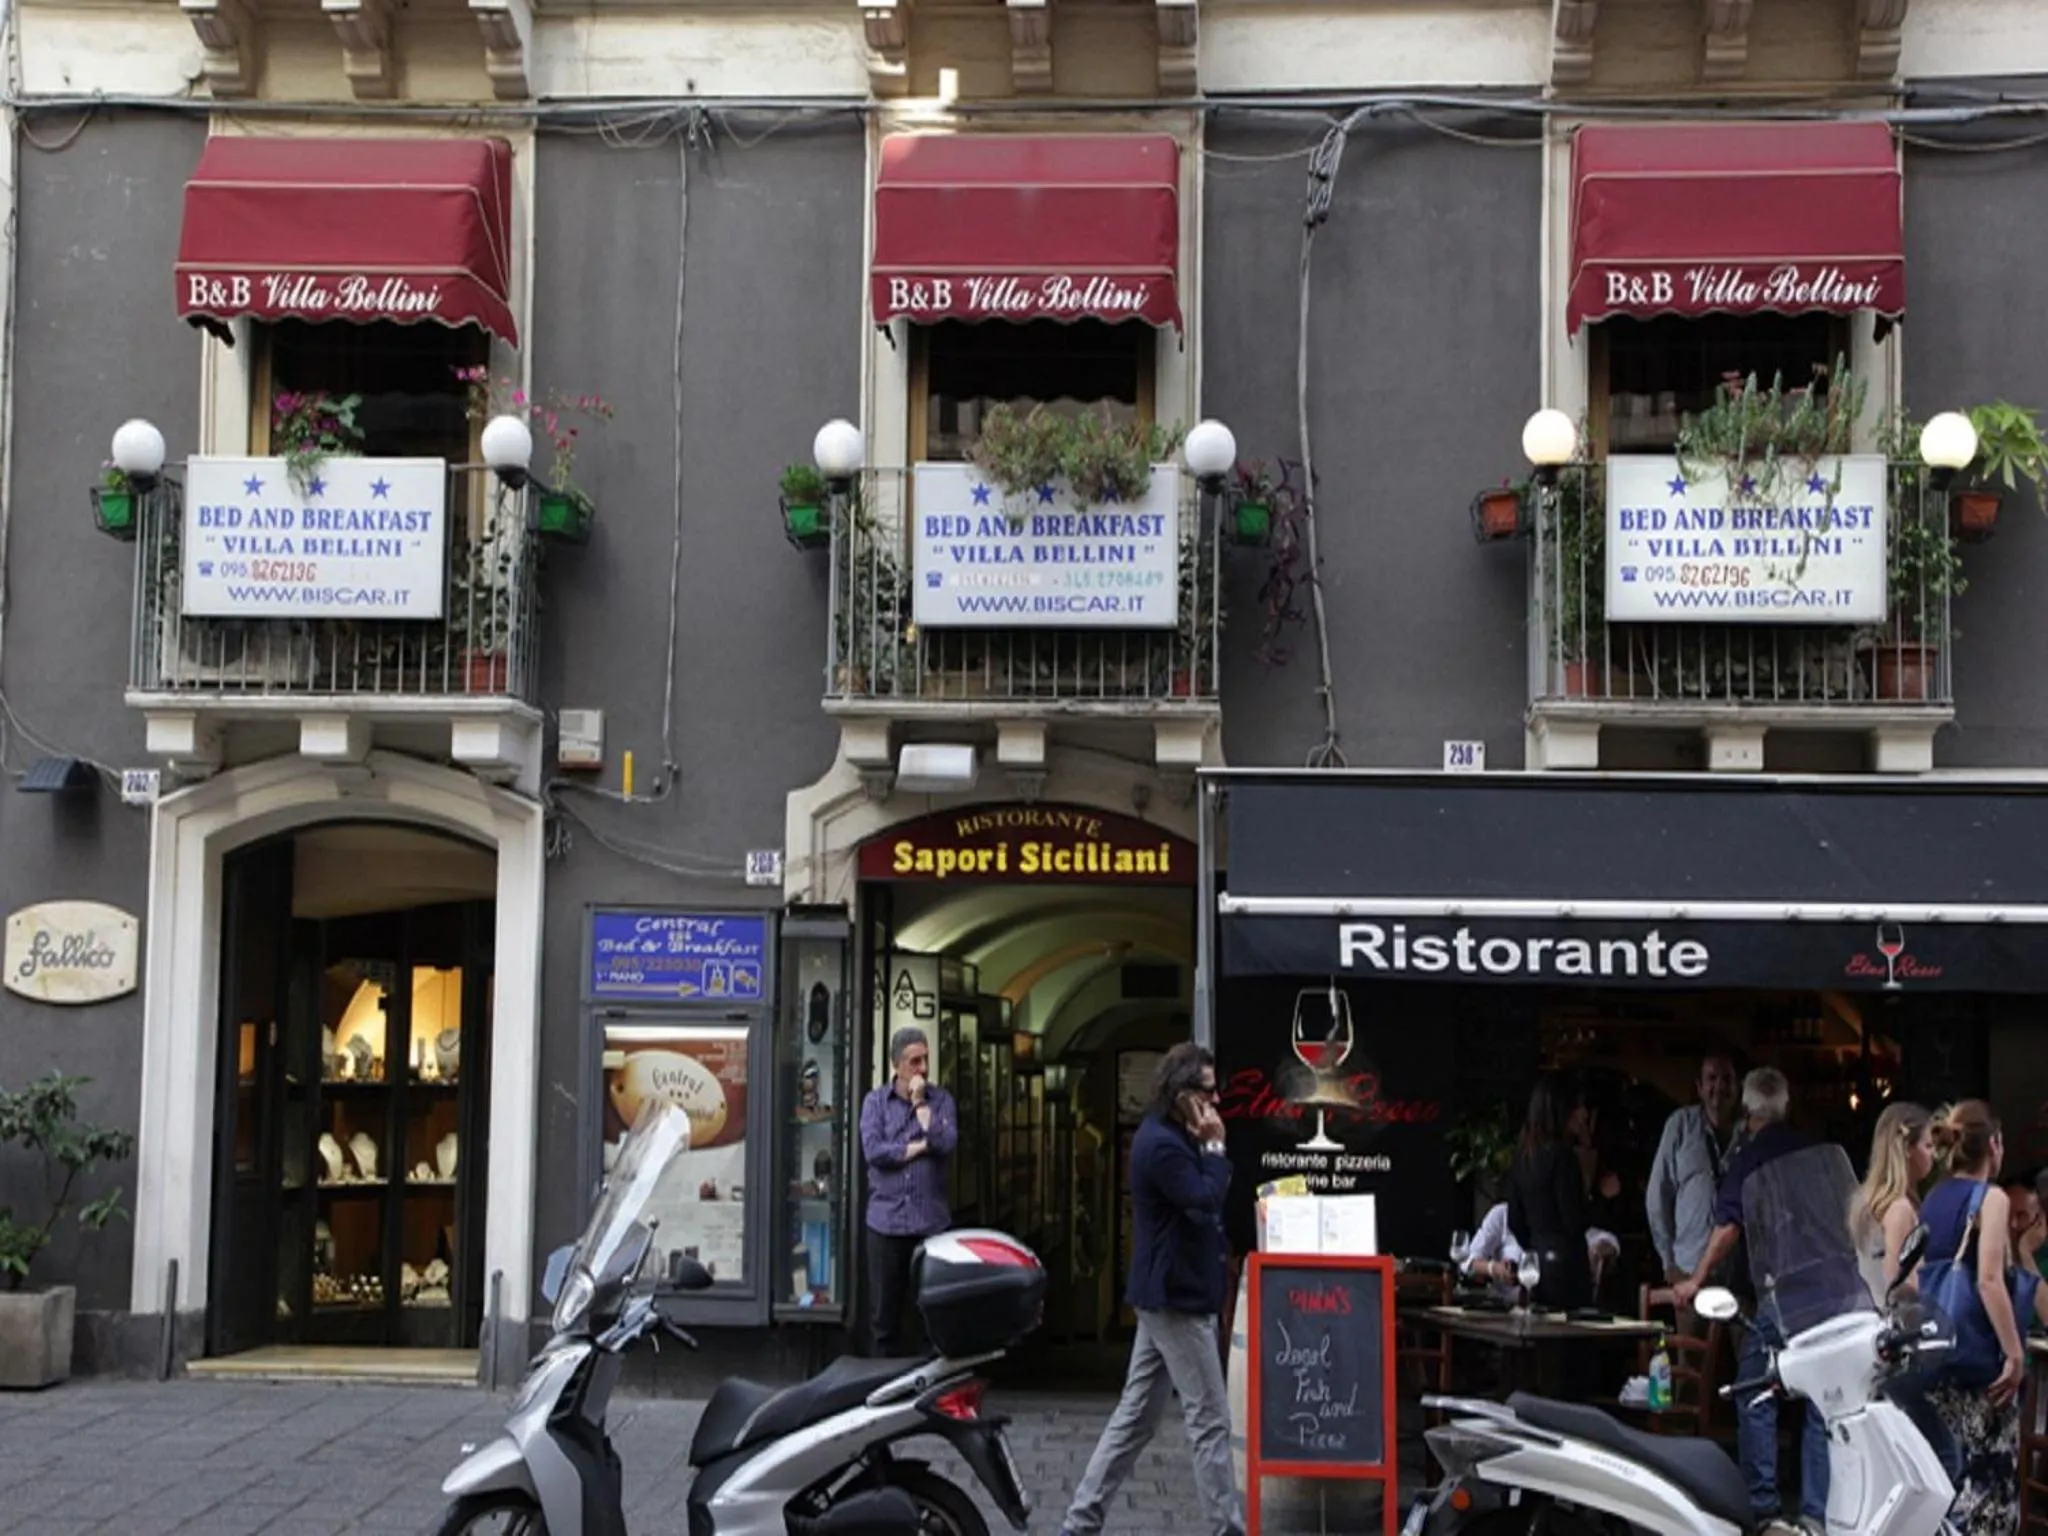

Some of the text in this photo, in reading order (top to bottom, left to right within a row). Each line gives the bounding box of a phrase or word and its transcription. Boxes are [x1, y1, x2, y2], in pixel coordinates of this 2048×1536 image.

[188, 273, 443, 312] B&B Villa Bellini
[889, 275, 1149, 311] B&B Villa Bellini
[1605, 265, 1882, 304] B&B Villa Bellini
[199, 505, 432, 533] BED AND BREAKFAST
[925, 514, 1165, 538] BED AND BREAKFAST
[1620, 508, 1667, 531] BED
[1674, 508, 1724, 531] AND
[223, 535, 402, 558] VILLA BELLINI
[950, 545, 1135, 563] VILLA BELLINI
[1646, 539, 1725, 558] VILLA
[227, 585, 410, 605] WWW.BISCAR.IT
[957, 596, 1144, 612] WWW.BISCAR.IT
[1653, 589, 1853, 607] WWW.BISCAR.IT
[955, 811, 1102, 839] RISTORANTE
[893, 840, 1170, 878] Sapori Siciliani
[635, 917, 724, 936] Central
[597, 936, 760, 956] Bed & Breakfast
[1338, 923, 1709, 977] Ristorante
[652, 1068, 704, 1095] Central
[1261, 1153, 1391, 1171] ristorante pizzeria
[1332, 1173, 1356, 1188] bar
